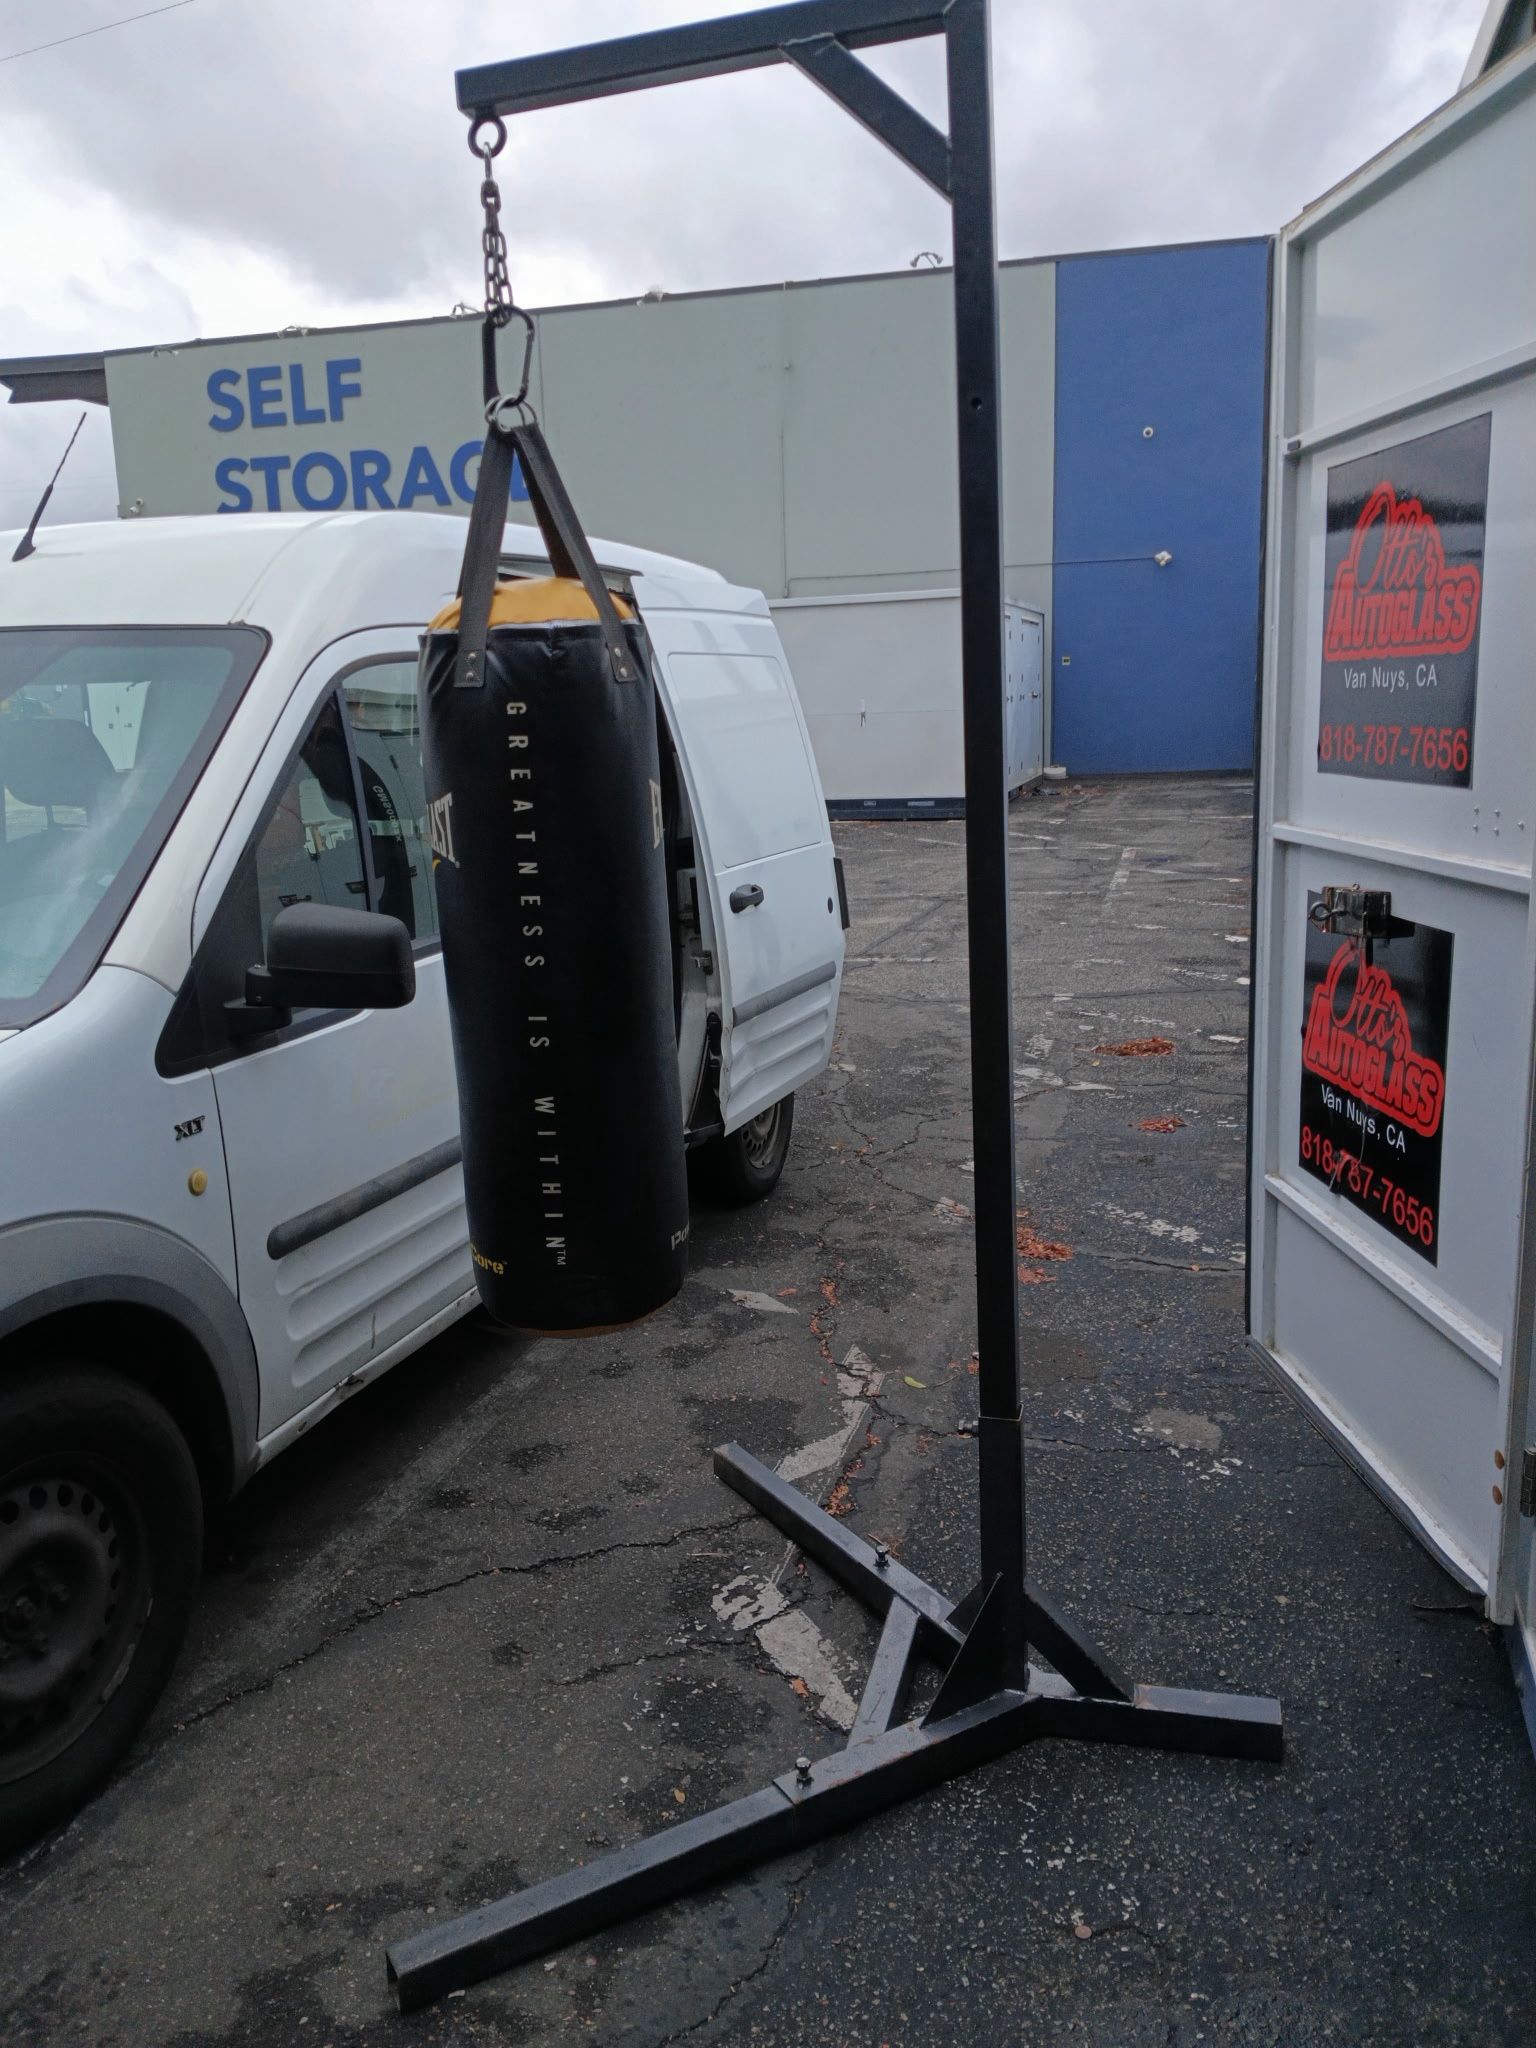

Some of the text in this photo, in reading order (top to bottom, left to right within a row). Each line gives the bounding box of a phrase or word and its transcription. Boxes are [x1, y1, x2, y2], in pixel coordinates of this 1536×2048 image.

[207, 358, 362, 432] SELF
[1354, 493, 1440, 594] Otto's
[1344, 664, 1438, 694] Van Nuys, CA
[1320, 724, 1469, 773] 818-787-7656
[505, 701, 545, 968] GREATNESS
[527, 1015, 550, 1049] IS
[1331, 952, 1405, 1055] Otto's
[1321, 1084, 1406, 1154] Van Nuys, CA
